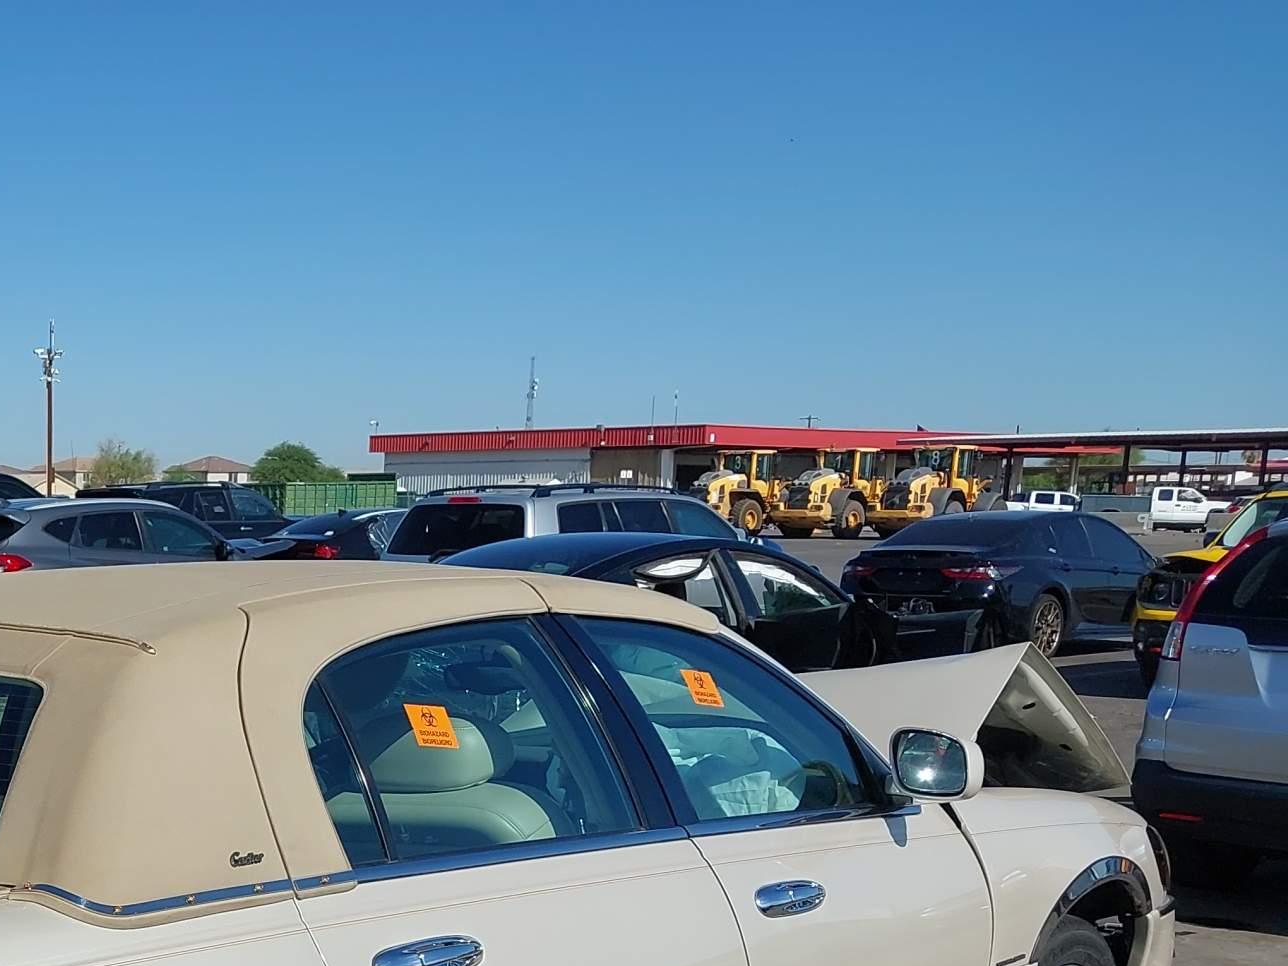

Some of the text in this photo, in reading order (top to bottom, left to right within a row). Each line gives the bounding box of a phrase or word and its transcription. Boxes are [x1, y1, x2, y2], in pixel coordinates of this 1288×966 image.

[734, 455, 742, 470] 3
[932, 450, 940, 465] 8
[419, 729, 450, 738] BIOHAZARD
[229, 851, 265, 868] Cartier
